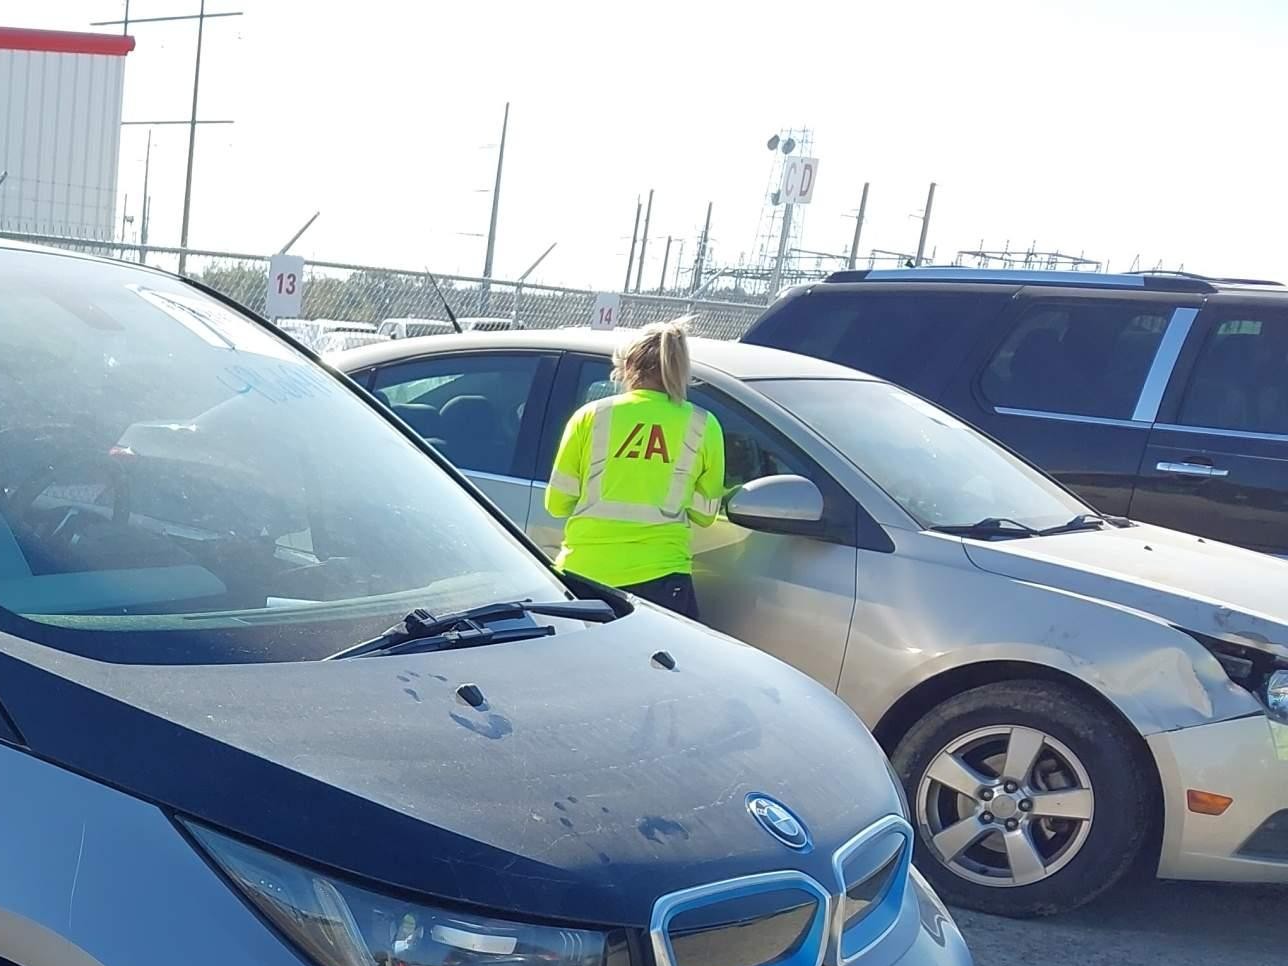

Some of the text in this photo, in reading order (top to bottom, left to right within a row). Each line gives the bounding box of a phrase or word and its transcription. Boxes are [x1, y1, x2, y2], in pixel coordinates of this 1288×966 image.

[799, 164, 813, 197] D
[277, 273, 297, 295] 13
[600, 308, 612, 325] 14
